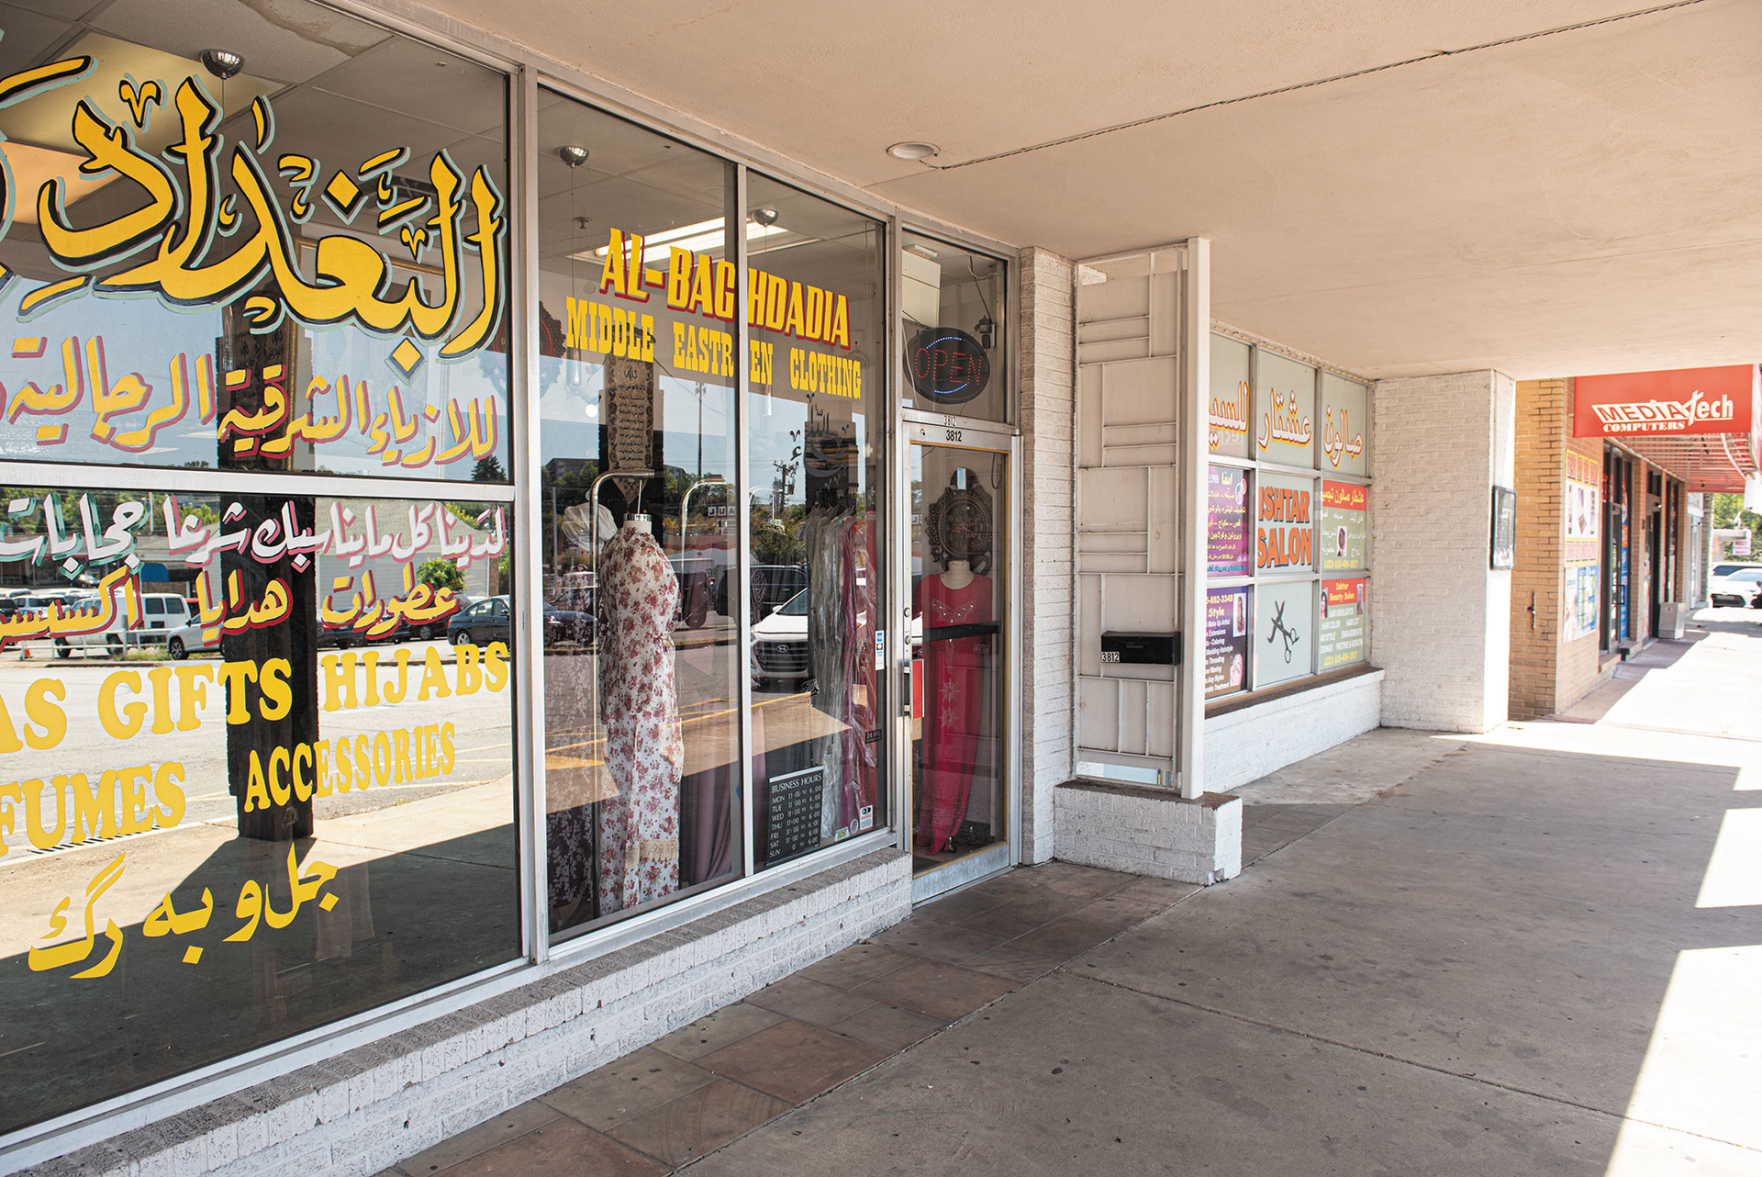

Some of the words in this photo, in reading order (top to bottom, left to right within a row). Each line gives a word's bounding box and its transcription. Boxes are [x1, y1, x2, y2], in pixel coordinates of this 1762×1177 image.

[0, 55, 507, 386] البغداد
[599, 227, 851, 350] AL-BAGHDADIA
[566, 296, 654, 363] MIDDLE
[790, 347, 862, 399] CLOTHING
[914, 347, 982, 385] OPEN
[8, 335, 217, 453] الرجالية
[217, 364, 370, 460] الشرقية
[1209, 381, 1249, 450] للسي
[1258, 388, 1312, 452] عشتار
[1603, 421, 1686, 433] COMPUTERS
[945, 429, 962, 442] 3812
[1324, 404, 1363, 469] صالون
[1258, 485, 1311, 524] ISHTAR
[1257, 526, 1312, 569] SALON
[0, 564, 142, 657] اكسس
[195, 568, 293, 648] هدايا
[321, 561, 460, 640] عطورات
[1208, 606, 1225, 619] Style
[98, 657, 293, 741] GIFTS
[321, 641, 508, 713] HIJABS
[1102, 652, 1119, 663] 3812
[244, 721, 456, 813] ACCESSORIES
[771, 780, 799, 793] BUSINESS
[800, 774, 822, 786] HOURS
